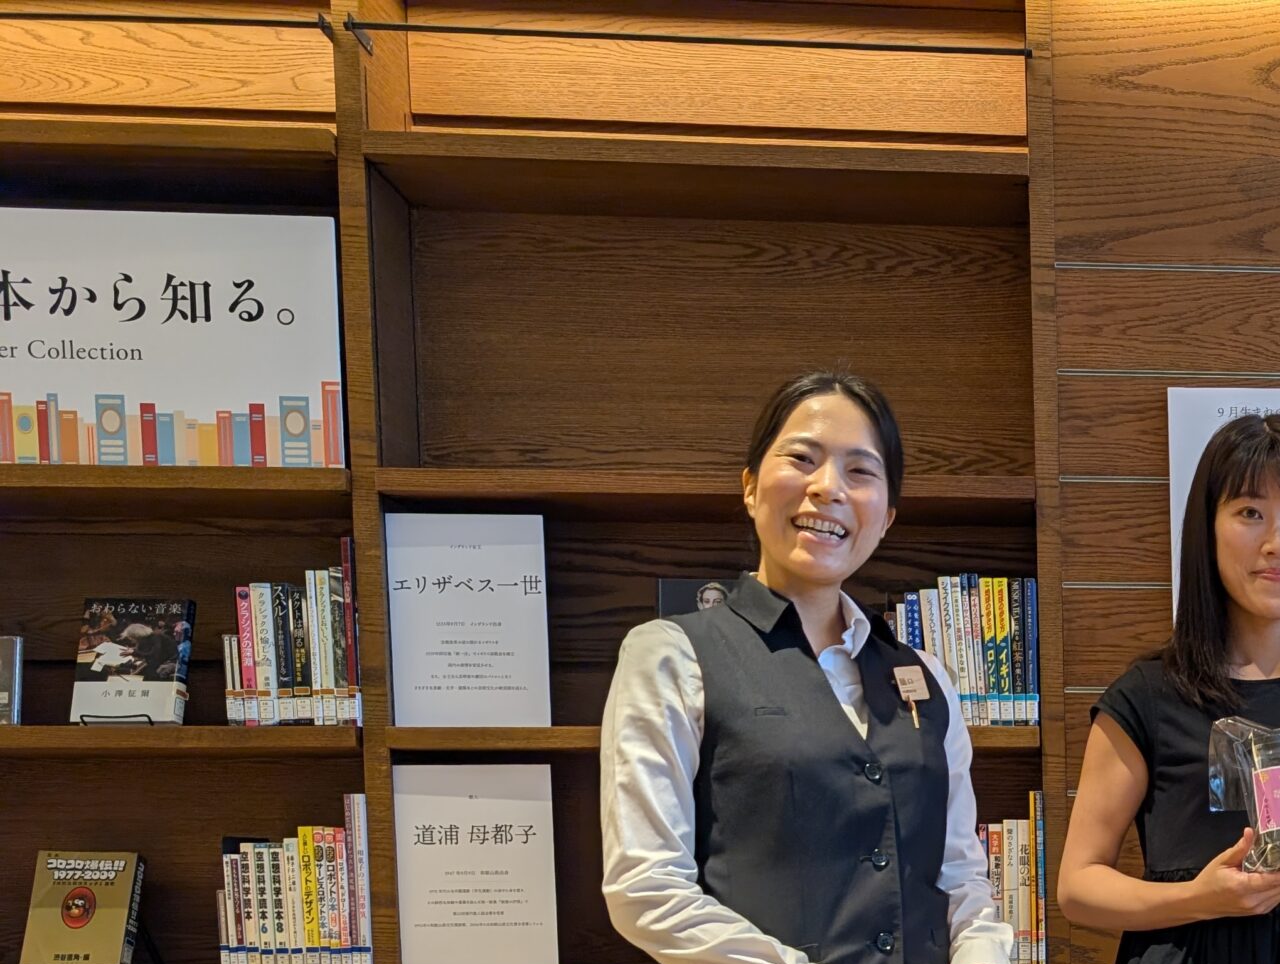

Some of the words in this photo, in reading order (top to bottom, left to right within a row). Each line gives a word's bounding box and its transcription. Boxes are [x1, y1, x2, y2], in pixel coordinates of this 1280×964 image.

[0, 270, 296, 326] 本から知る。
[28, 339, 143, 361] Collection
[393, 575, 543, 596] エリザベス一世
[90, 603, 182, 614] おわらない音楽
[999, 649, 1009, 694] イギリ
[413, 824, 460, 845] 道浦
[467, 824, 537, 845] 母都子
[53, 870, 116, 880] 1977-2009
[1019, 844, 1030, 887] 花眼の記
[240, 851, 252, 920] 空想科学読本
